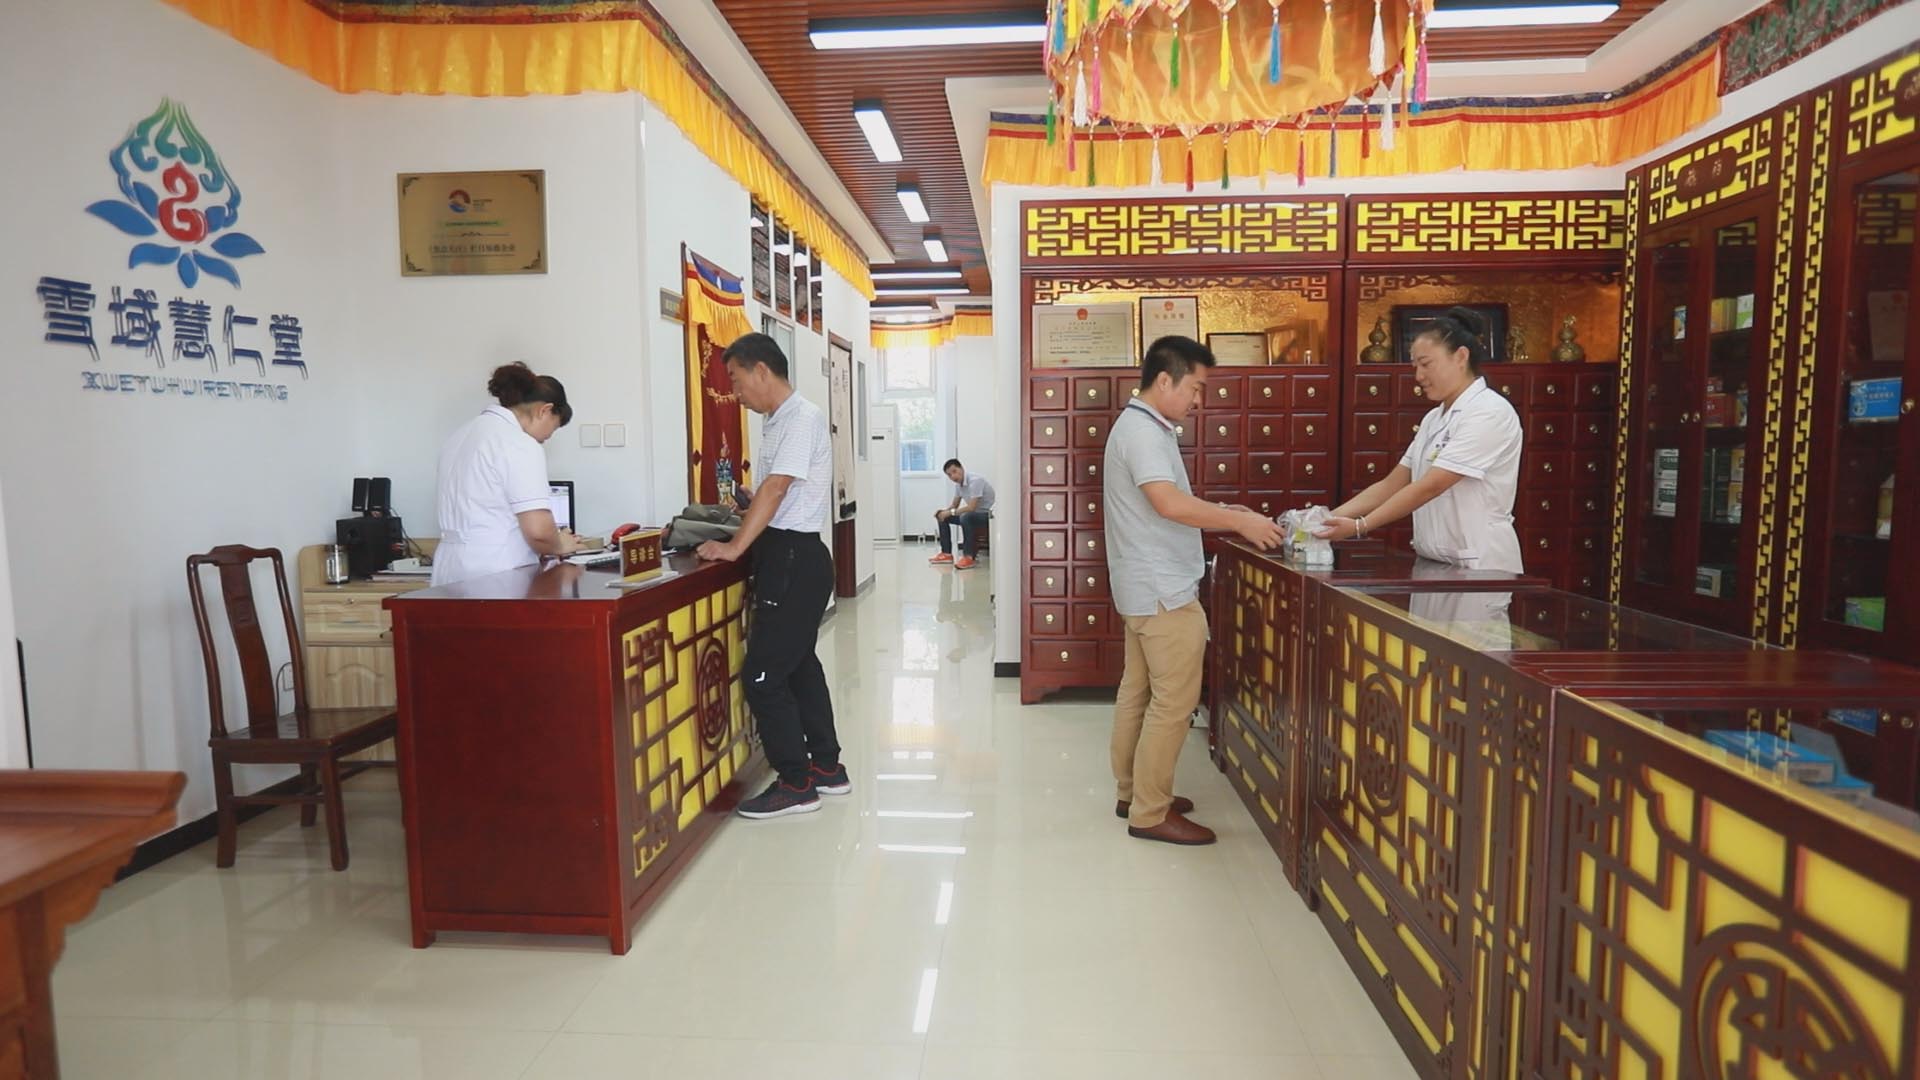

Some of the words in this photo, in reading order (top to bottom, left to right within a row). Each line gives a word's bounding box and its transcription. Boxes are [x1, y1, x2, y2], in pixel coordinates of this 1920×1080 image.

[37, 276, 308, 380] 雪域慧仁堂
